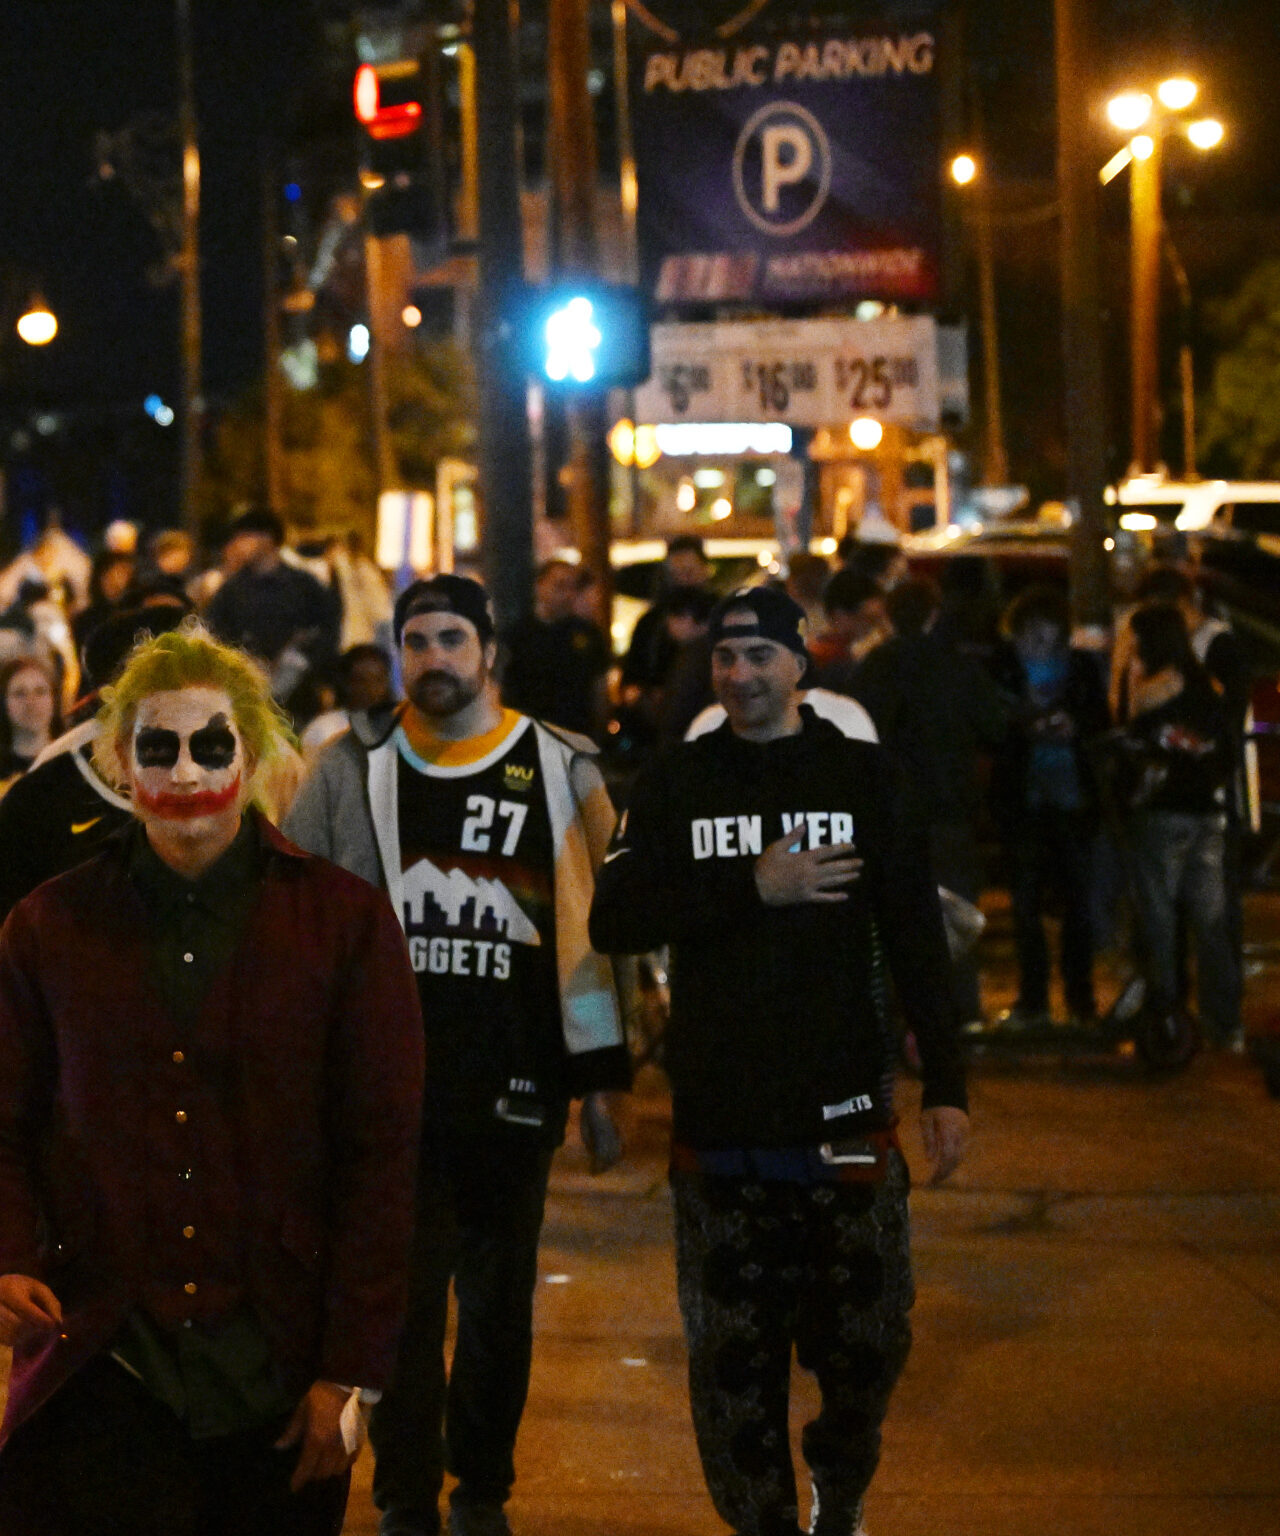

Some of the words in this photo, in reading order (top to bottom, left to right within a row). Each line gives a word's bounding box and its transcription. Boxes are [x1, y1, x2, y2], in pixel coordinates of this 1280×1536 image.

[644, 47, 768, 92] PUBLIC
[775, 33, 934, 82] PARKING
[761, 124, 813, 214] P
[461, 794, 528, 857] 27
[408, 935, 512, 981] GGETS
